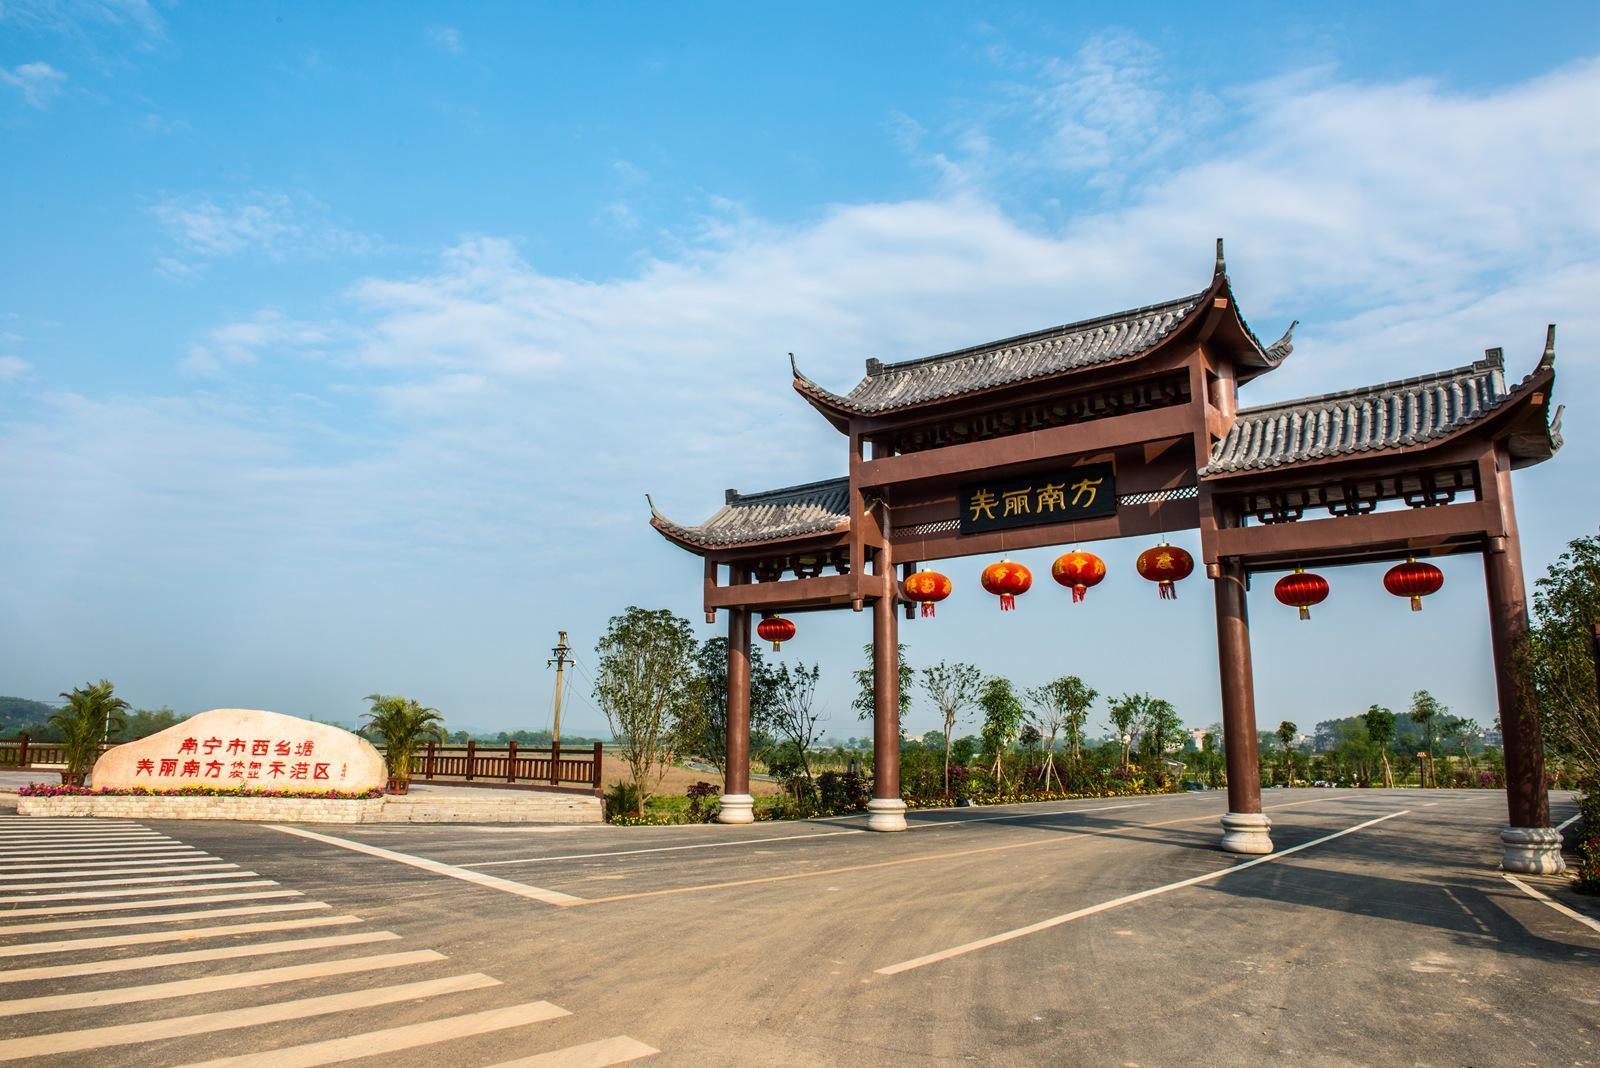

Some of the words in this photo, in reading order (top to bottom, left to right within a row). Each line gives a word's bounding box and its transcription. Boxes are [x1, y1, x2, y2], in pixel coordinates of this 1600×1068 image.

[969, 477, 1103, 522] 美丽南方
[177, 736, 315, 757] 南宁市西乡塘
